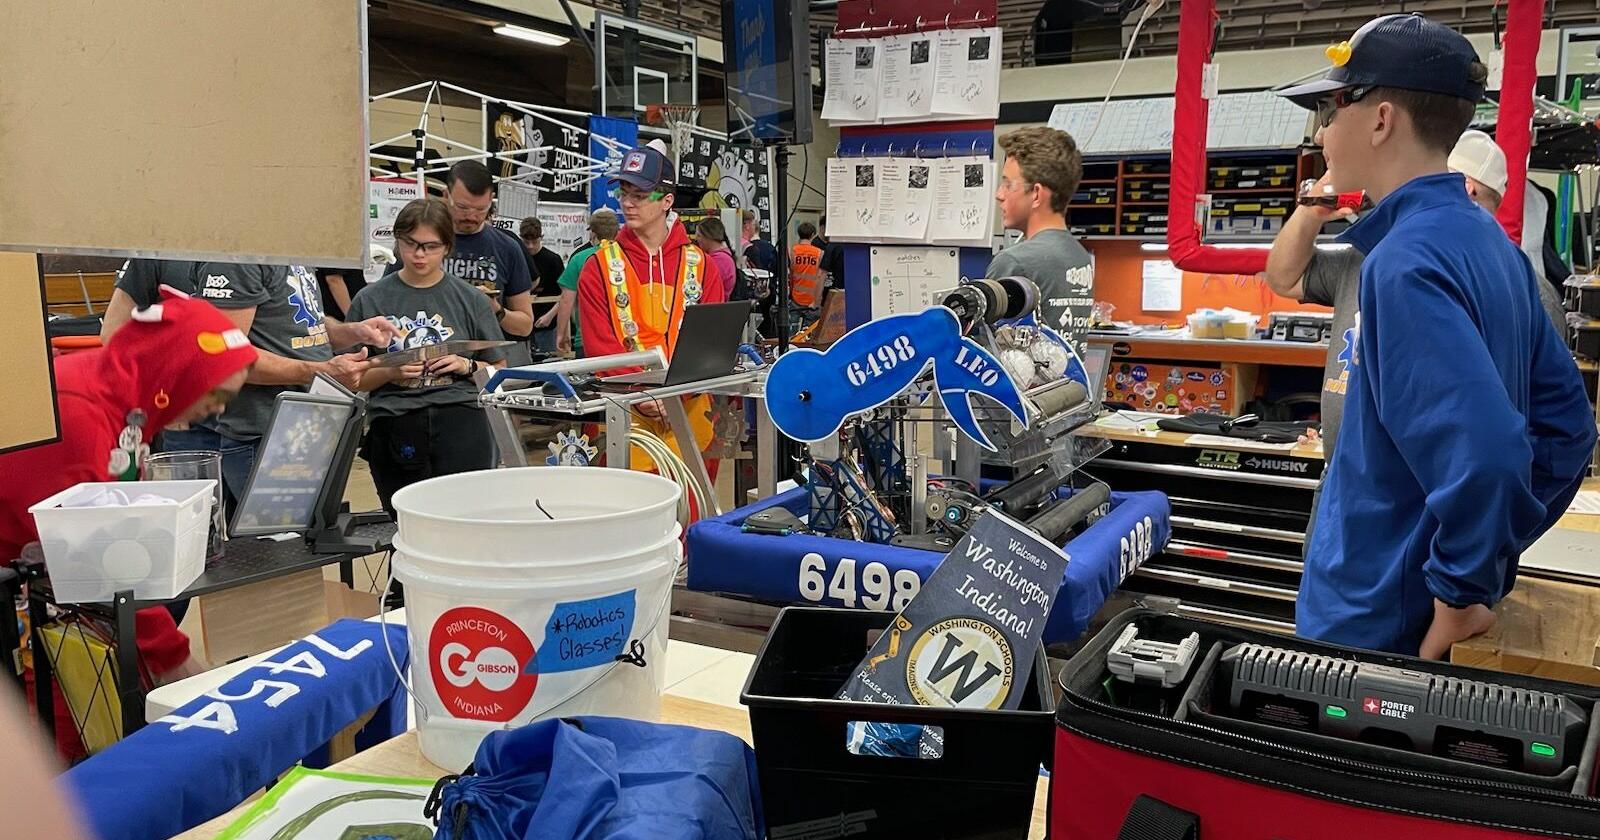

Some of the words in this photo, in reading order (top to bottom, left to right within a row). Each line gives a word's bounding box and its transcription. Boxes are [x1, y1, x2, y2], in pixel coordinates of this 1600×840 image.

[561, 128, 580, 148] THE
[558, 215, 585, 224] TOYOTA
[795, 256, 817, 266] 8116
[202, 288, 235, 299] FIRST
[846, 335, 916, 387] 6498
[954, 346, 1001, 387] LEO
[1199, 449, 1240, 464] CTR
[1261, 459, 1310, 473] HUSKY
[1008, 538, 1041, 567] Welcome
[1040, 560, 1048, 571] to
[1119, 516, 1153, 585] 6498
[799, 553, 921, 612] 6498
[965, 535, 1050, 617] Washington,
[955, 574, 1034, 639] Indiana!
[445, 619, 508, 642] PRINCETON
[559, 629, 627, 661] Glasses!
[440, 642, 520, 692] GO
[476, 663, 517, 675] GIBSON
[926, 631, 1002, 704] W
[928, 618, 999, 641] WASHINGTON
[996, 637, 1014, 688] SCHOOLS
[157, 634, 374, 735] 7454
[857, 669, 882, 694] Please
[881, 691, 901, 705] enjo
[453, 696, 504, 716] INDIANA
[1380, 707, 1408, 720] CABLE
[1381, 700, 1416, 713] PORTER
